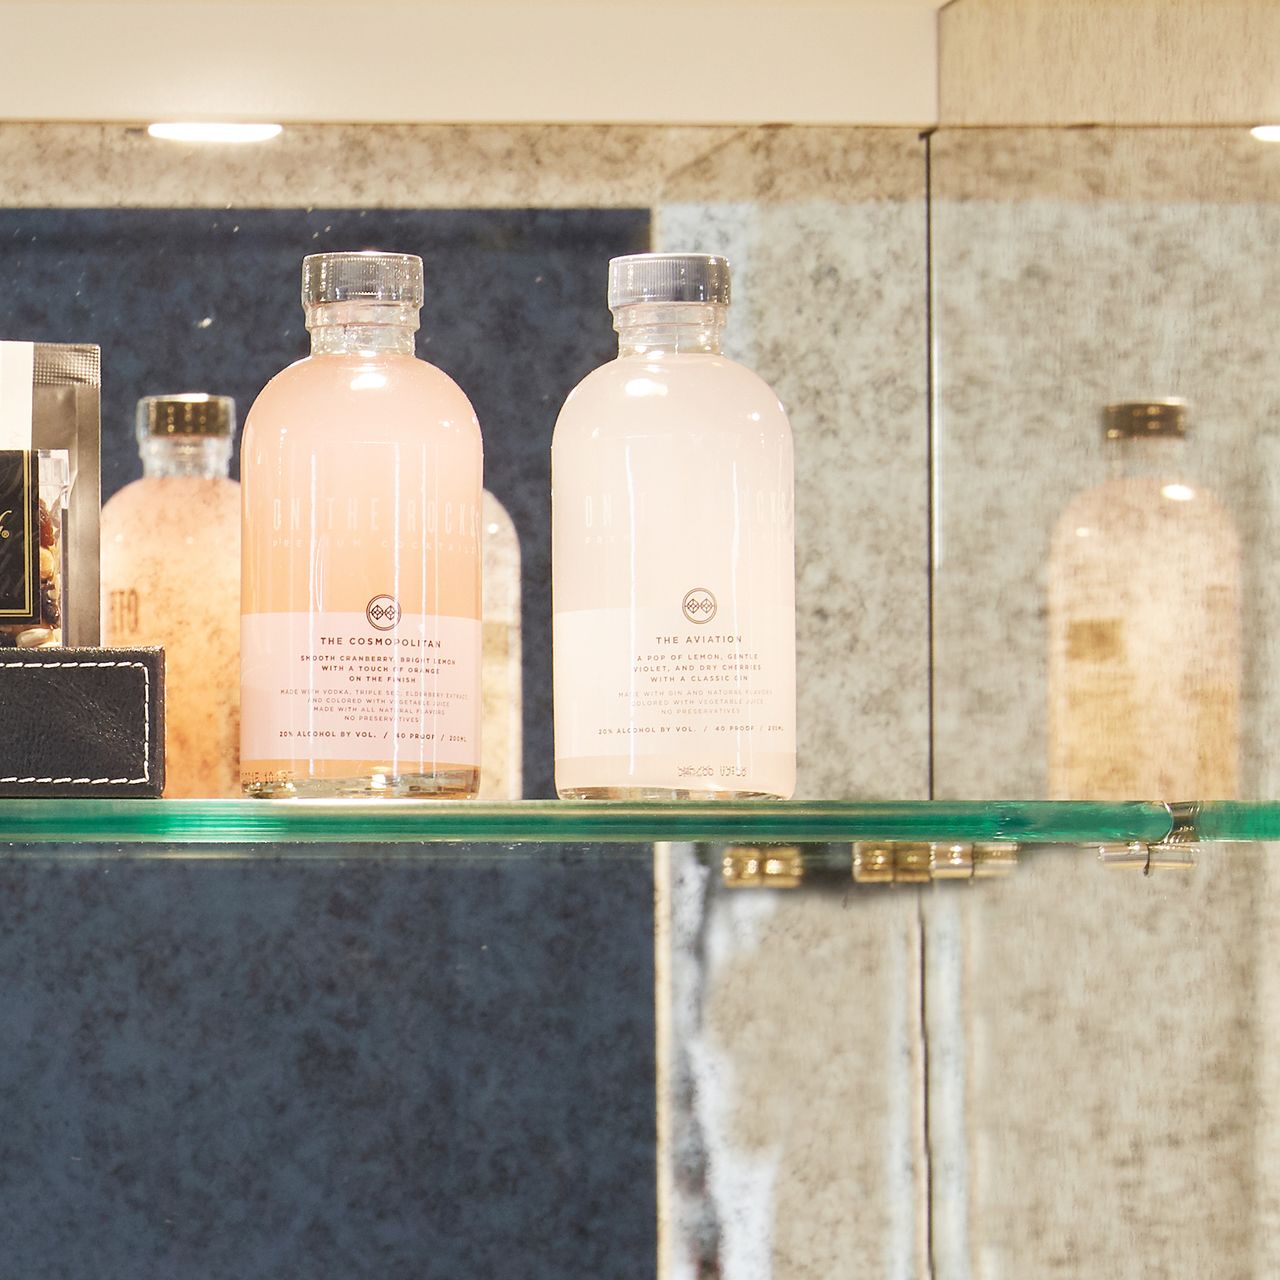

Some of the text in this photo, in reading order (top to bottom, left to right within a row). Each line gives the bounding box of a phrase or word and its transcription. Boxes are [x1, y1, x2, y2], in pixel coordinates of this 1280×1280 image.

[320, 637, 442, 648] THE COSMOPOLITAN
[686, 636, 743, 644] AVIATION
